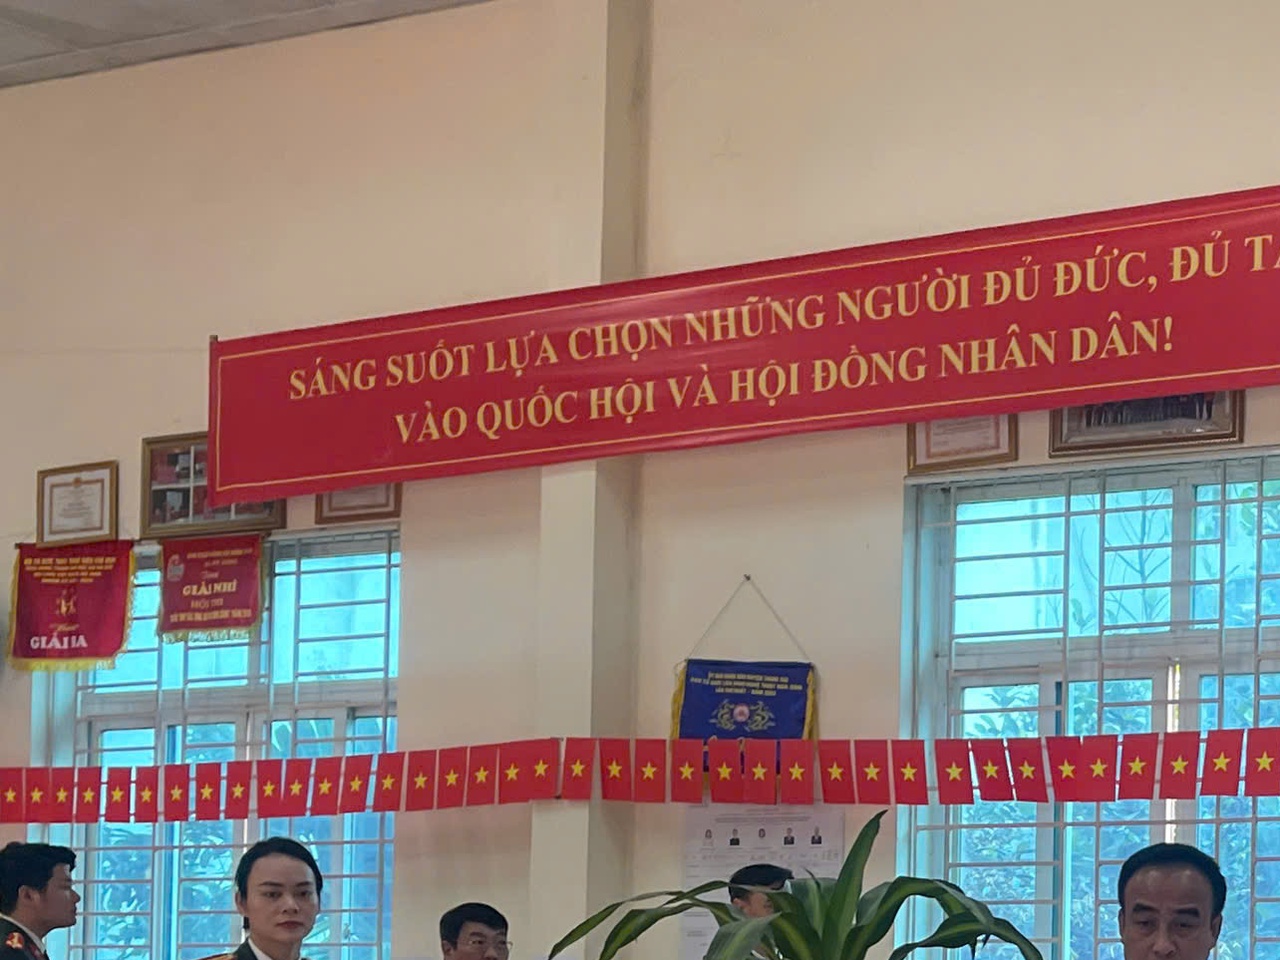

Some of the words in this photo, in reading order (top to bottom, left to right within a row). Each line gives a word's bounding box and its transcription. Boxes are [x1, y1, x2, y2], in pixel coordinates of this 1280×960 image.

[290, 357, 376, 399] SÁNG
[386, 339, 474, 387] SUỐT
[485, 330, 558, 377] LỰA
[569, 314, 673, 361] CHỌN
[684, 295, 825, 345] NHỮNG
[837, 267, 971, 326] NGƯỜI
[982, 255, 1041, 306] ĐỦ
[1053, 245, 1157, 298] ĐỨC,
[1169, 230, 1230, 282] ĐỦ
[395, 400, 467, 443] VÀO
[476, 385, 578, 439] QUỐC
[588, 378, 655, 424] HỘI
[667, 364, 718, 408] VÀ
[729, 360, 800, 407] HỘI
[811, 345, 926, 393] ĐỒNG
[939, 323, 1057, 379] NHÂN
[1070, 310, 1173, 363] DÂN!
